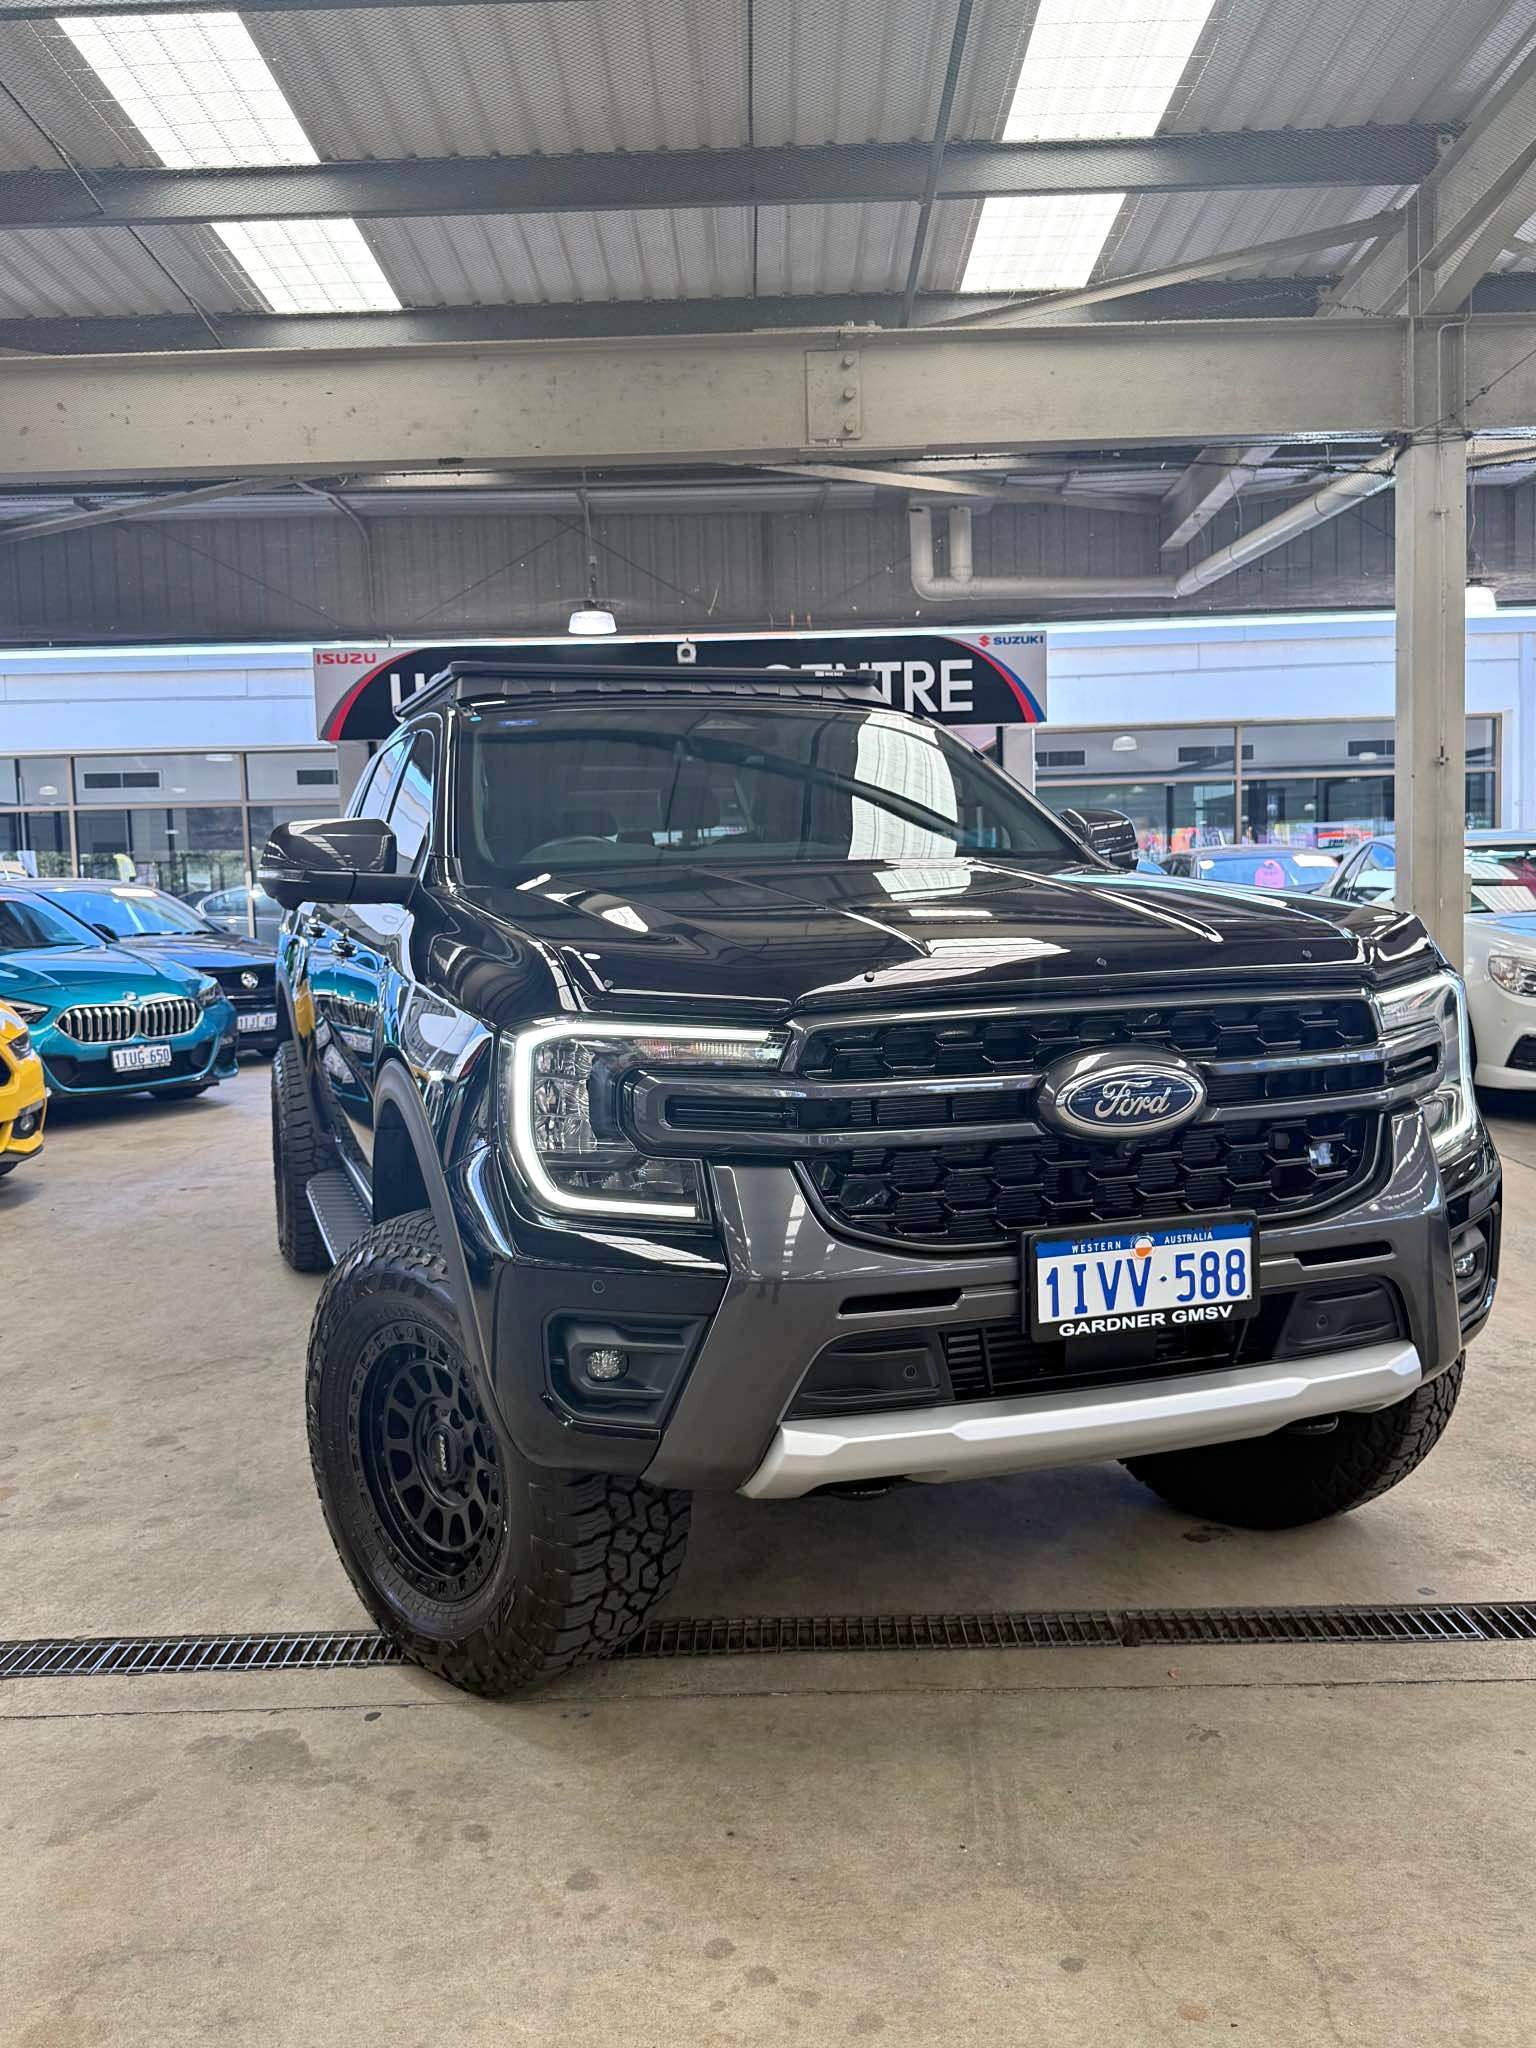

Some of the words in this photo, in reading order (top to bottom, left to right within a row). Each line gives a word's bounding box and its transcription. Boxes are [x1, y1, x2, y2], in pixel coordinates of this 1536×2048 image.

[993, 636, 1044, 646] SUZUKI
[316, 653, 377, 665] ISUZU
[1094, 1080, 1171, 1118] Ford
[1071, 1240, 1122, 1254] WESTERN
[1164, 1231, 1213, 1245] AUSTRALIA
[1058, 1312, 1166, 1337] GARDNER
[1171, 1304, 1233, 1324] GMSV
